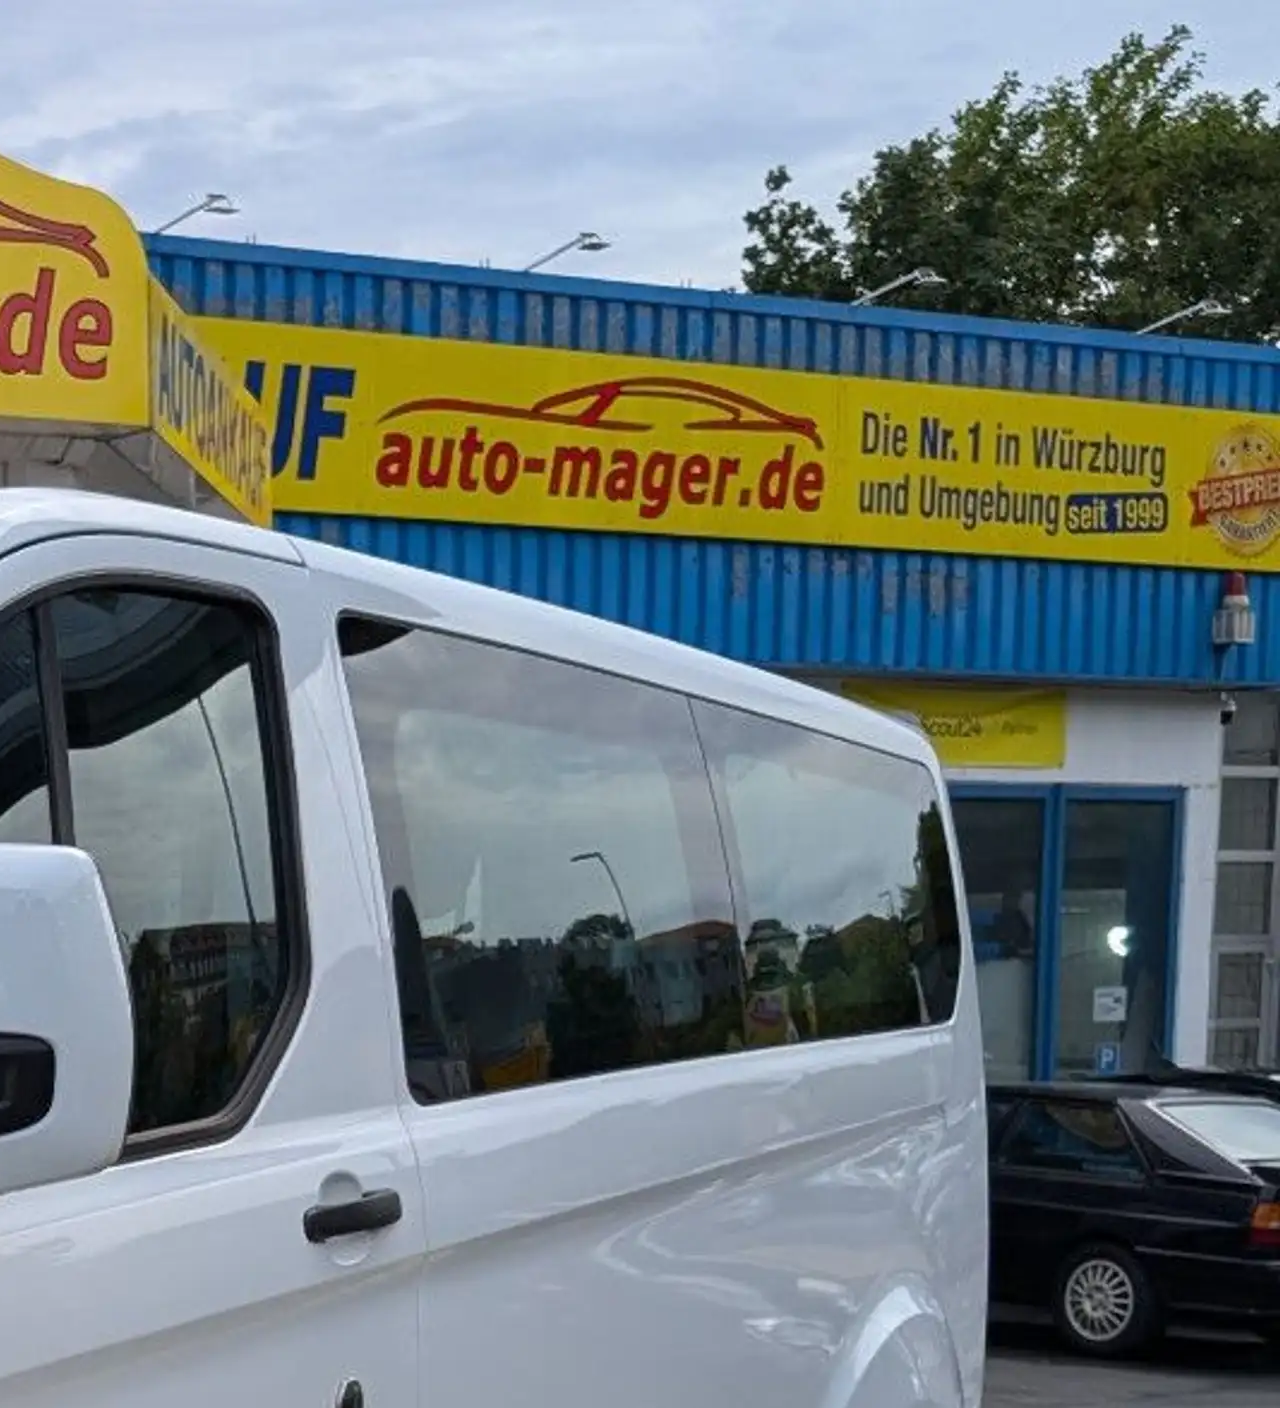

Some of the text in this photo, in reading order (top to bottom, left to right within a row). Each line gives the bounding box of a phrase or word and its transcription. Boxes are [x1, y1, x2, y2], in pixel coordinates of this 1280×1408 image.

[374, 425, 826, 520] auto-mager.de
[861, 411, 1168, 489] Die Nr. 1 in Würzburg
[858, 473, 1166, 537] und Umgebung seit 1999
